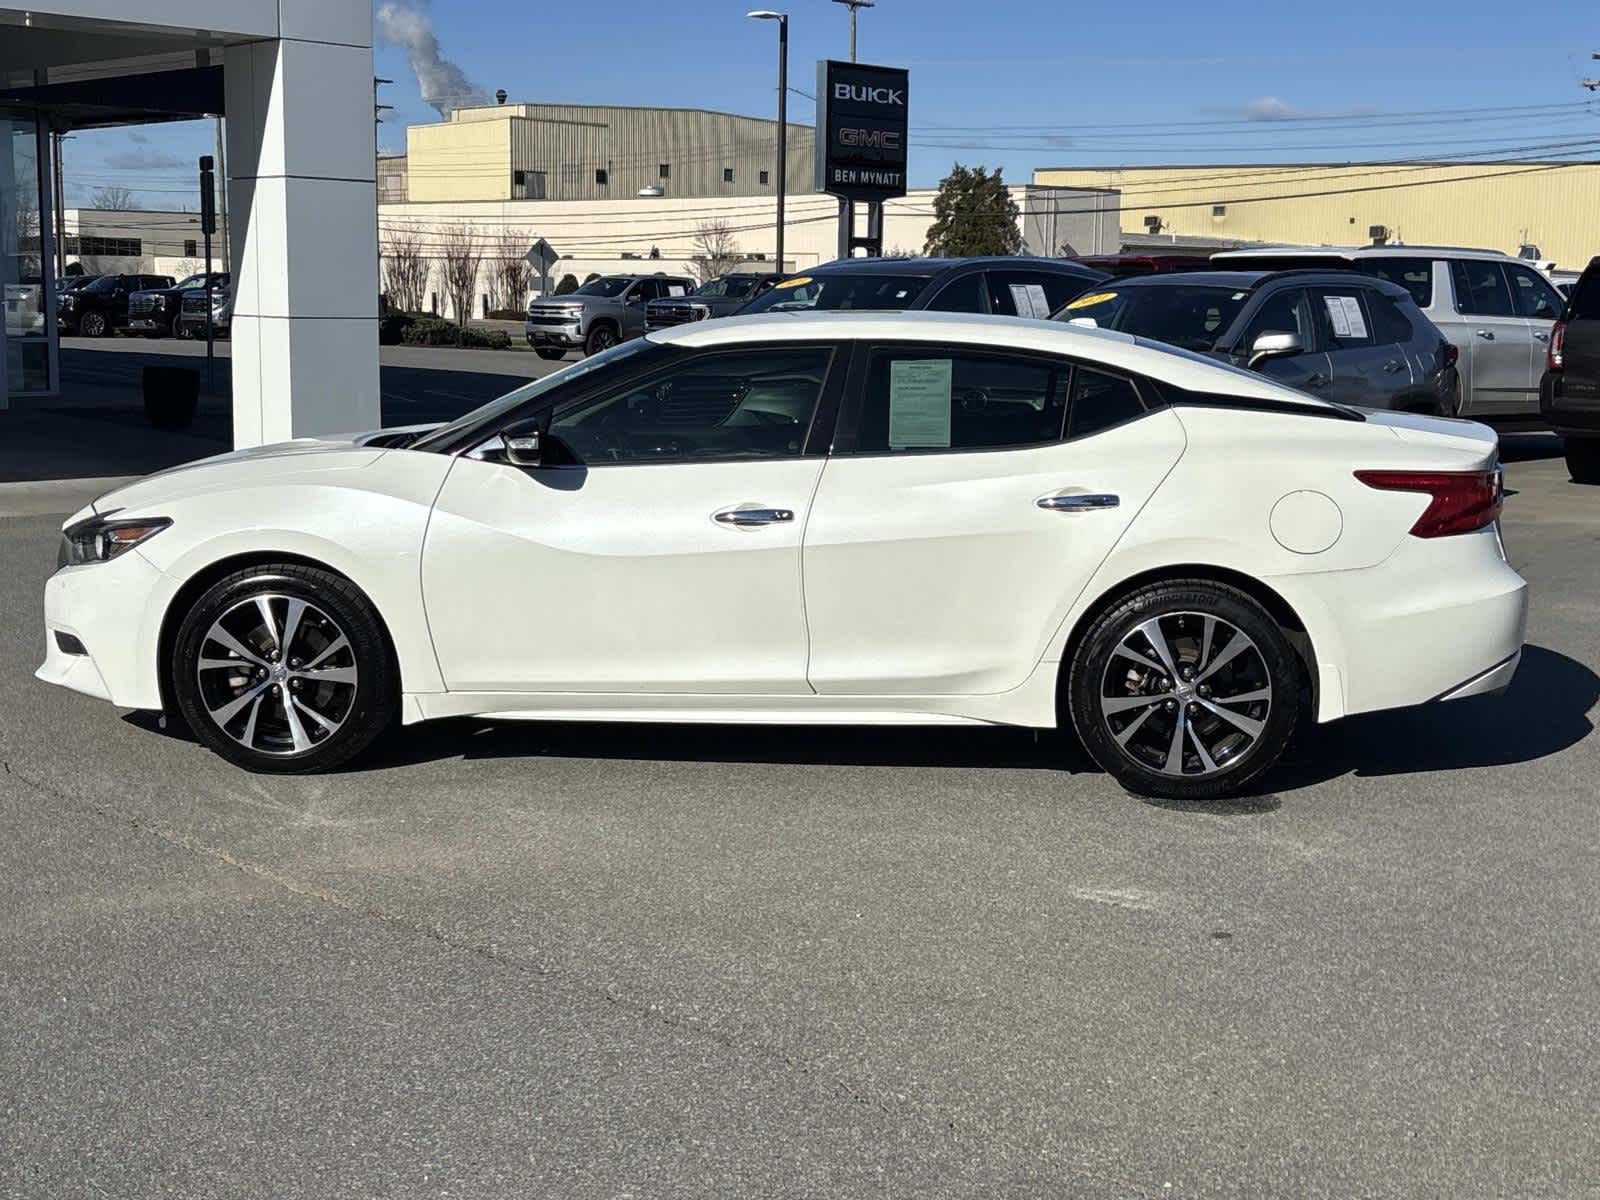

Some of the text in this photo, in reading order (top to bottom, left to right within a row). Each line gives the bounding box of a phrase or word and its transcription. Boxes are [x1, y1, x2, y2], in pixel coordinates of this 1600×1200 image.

[834, 83, 904, 105] BUICK
[839, 127, 900, 149] GMC
[834, 169, 900, 186] BEN MYNATT
